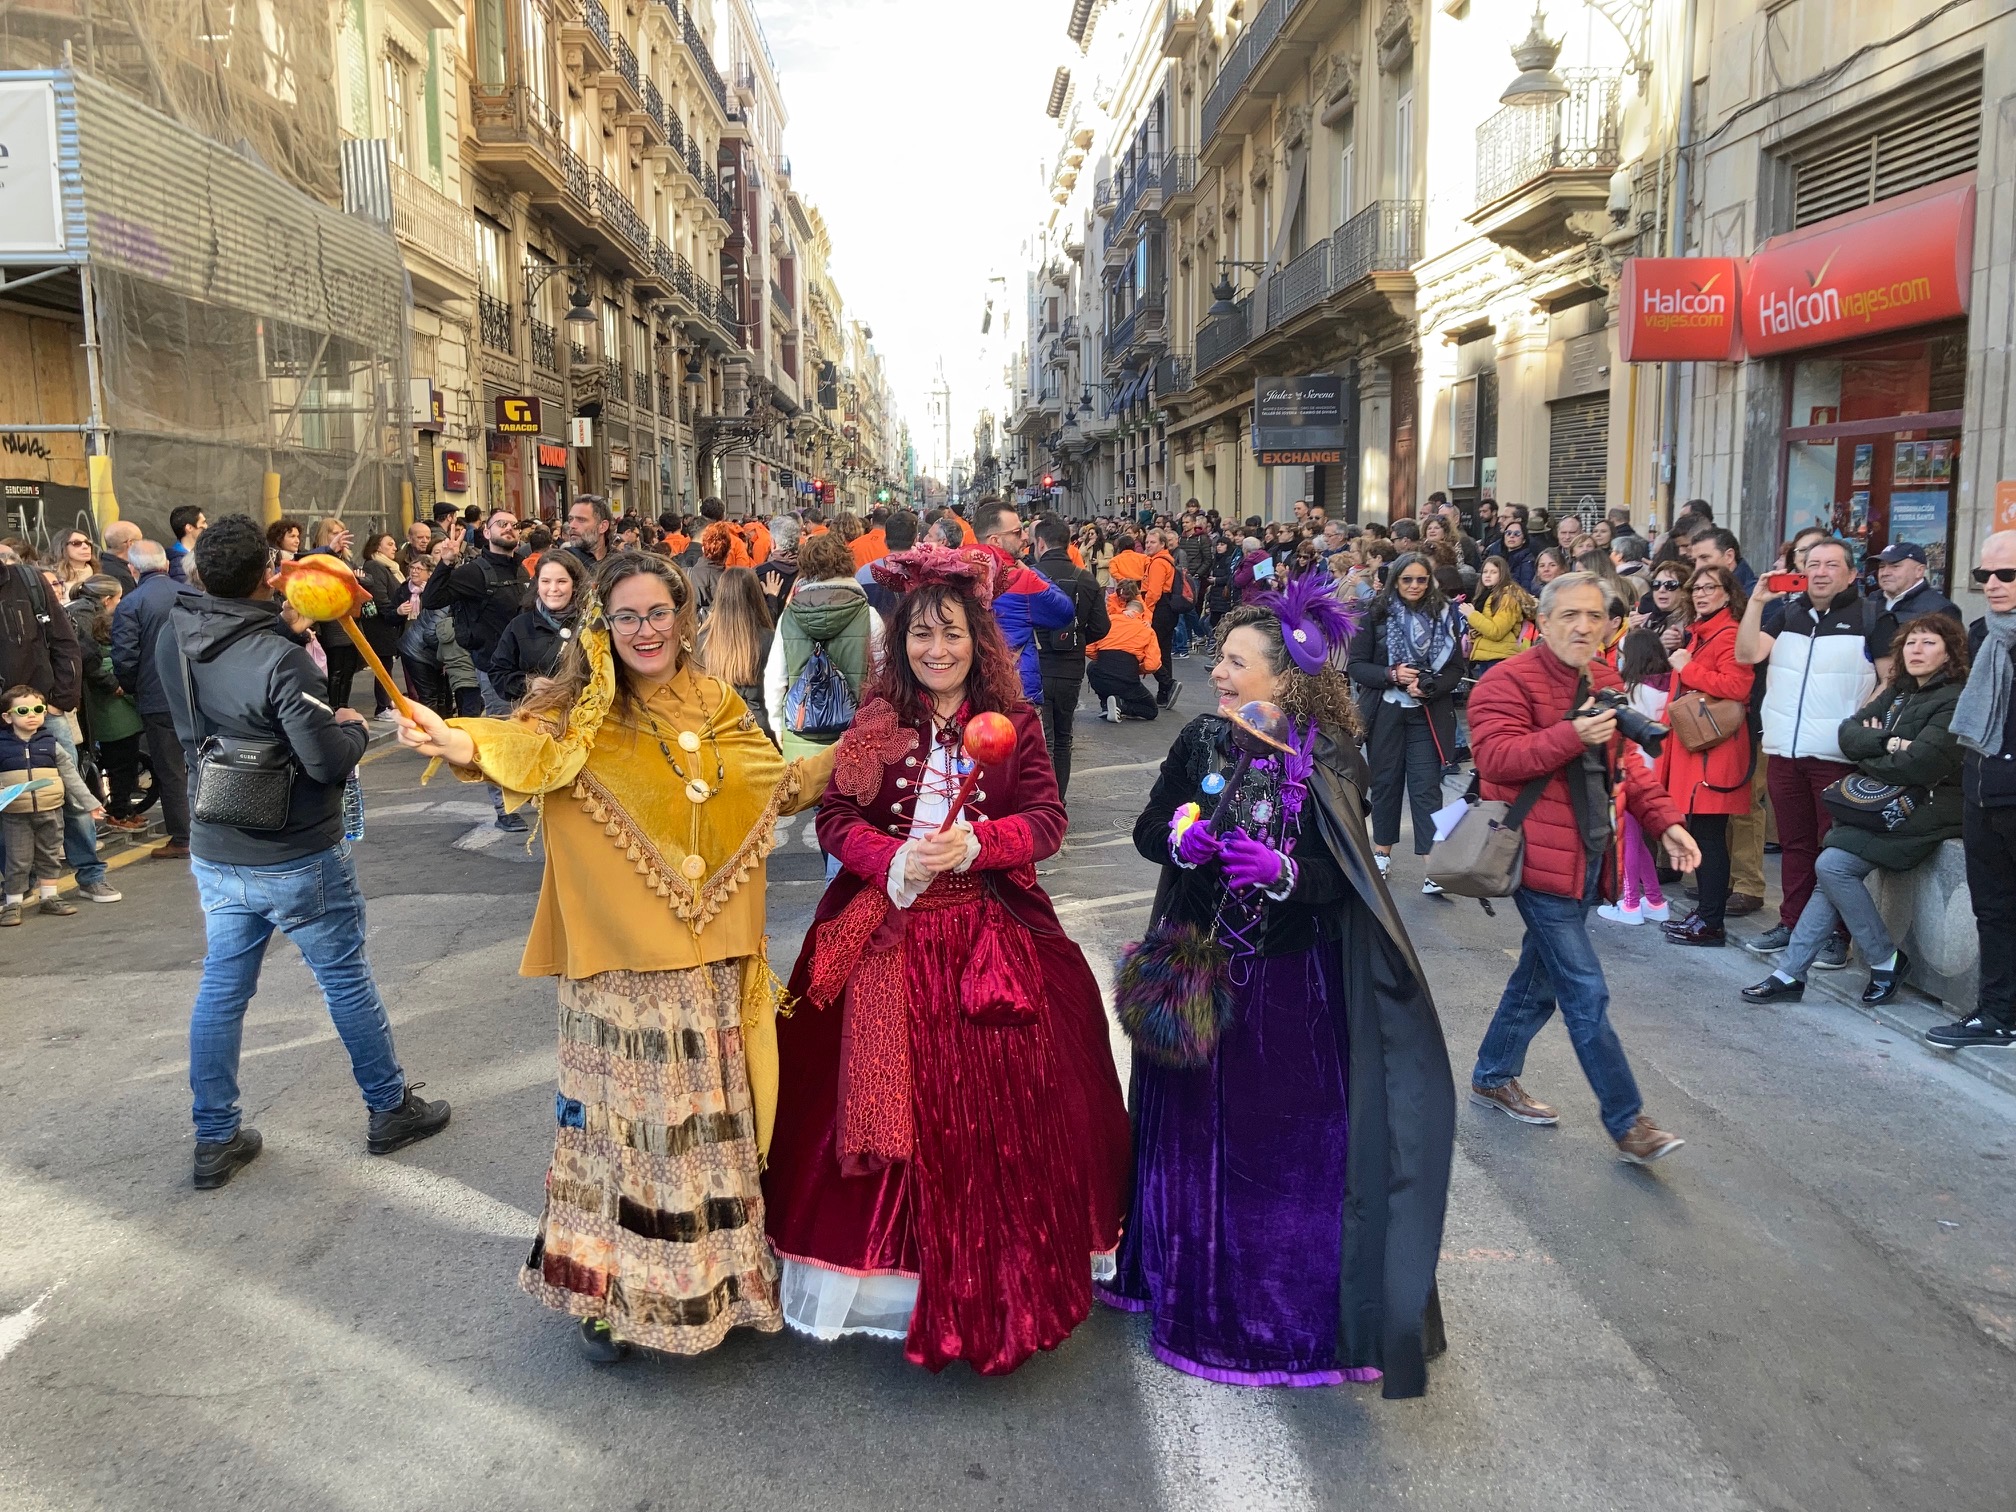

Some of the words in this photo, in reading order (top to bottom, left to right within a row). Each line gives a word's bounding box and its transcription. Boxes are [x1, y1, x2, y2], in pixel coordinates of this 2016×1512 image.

[1304, 389, 1334, 398] Serena
[499, 423, 539, 432] TABACOS
[1263, 452, 1340, 464] EXCHANGE
